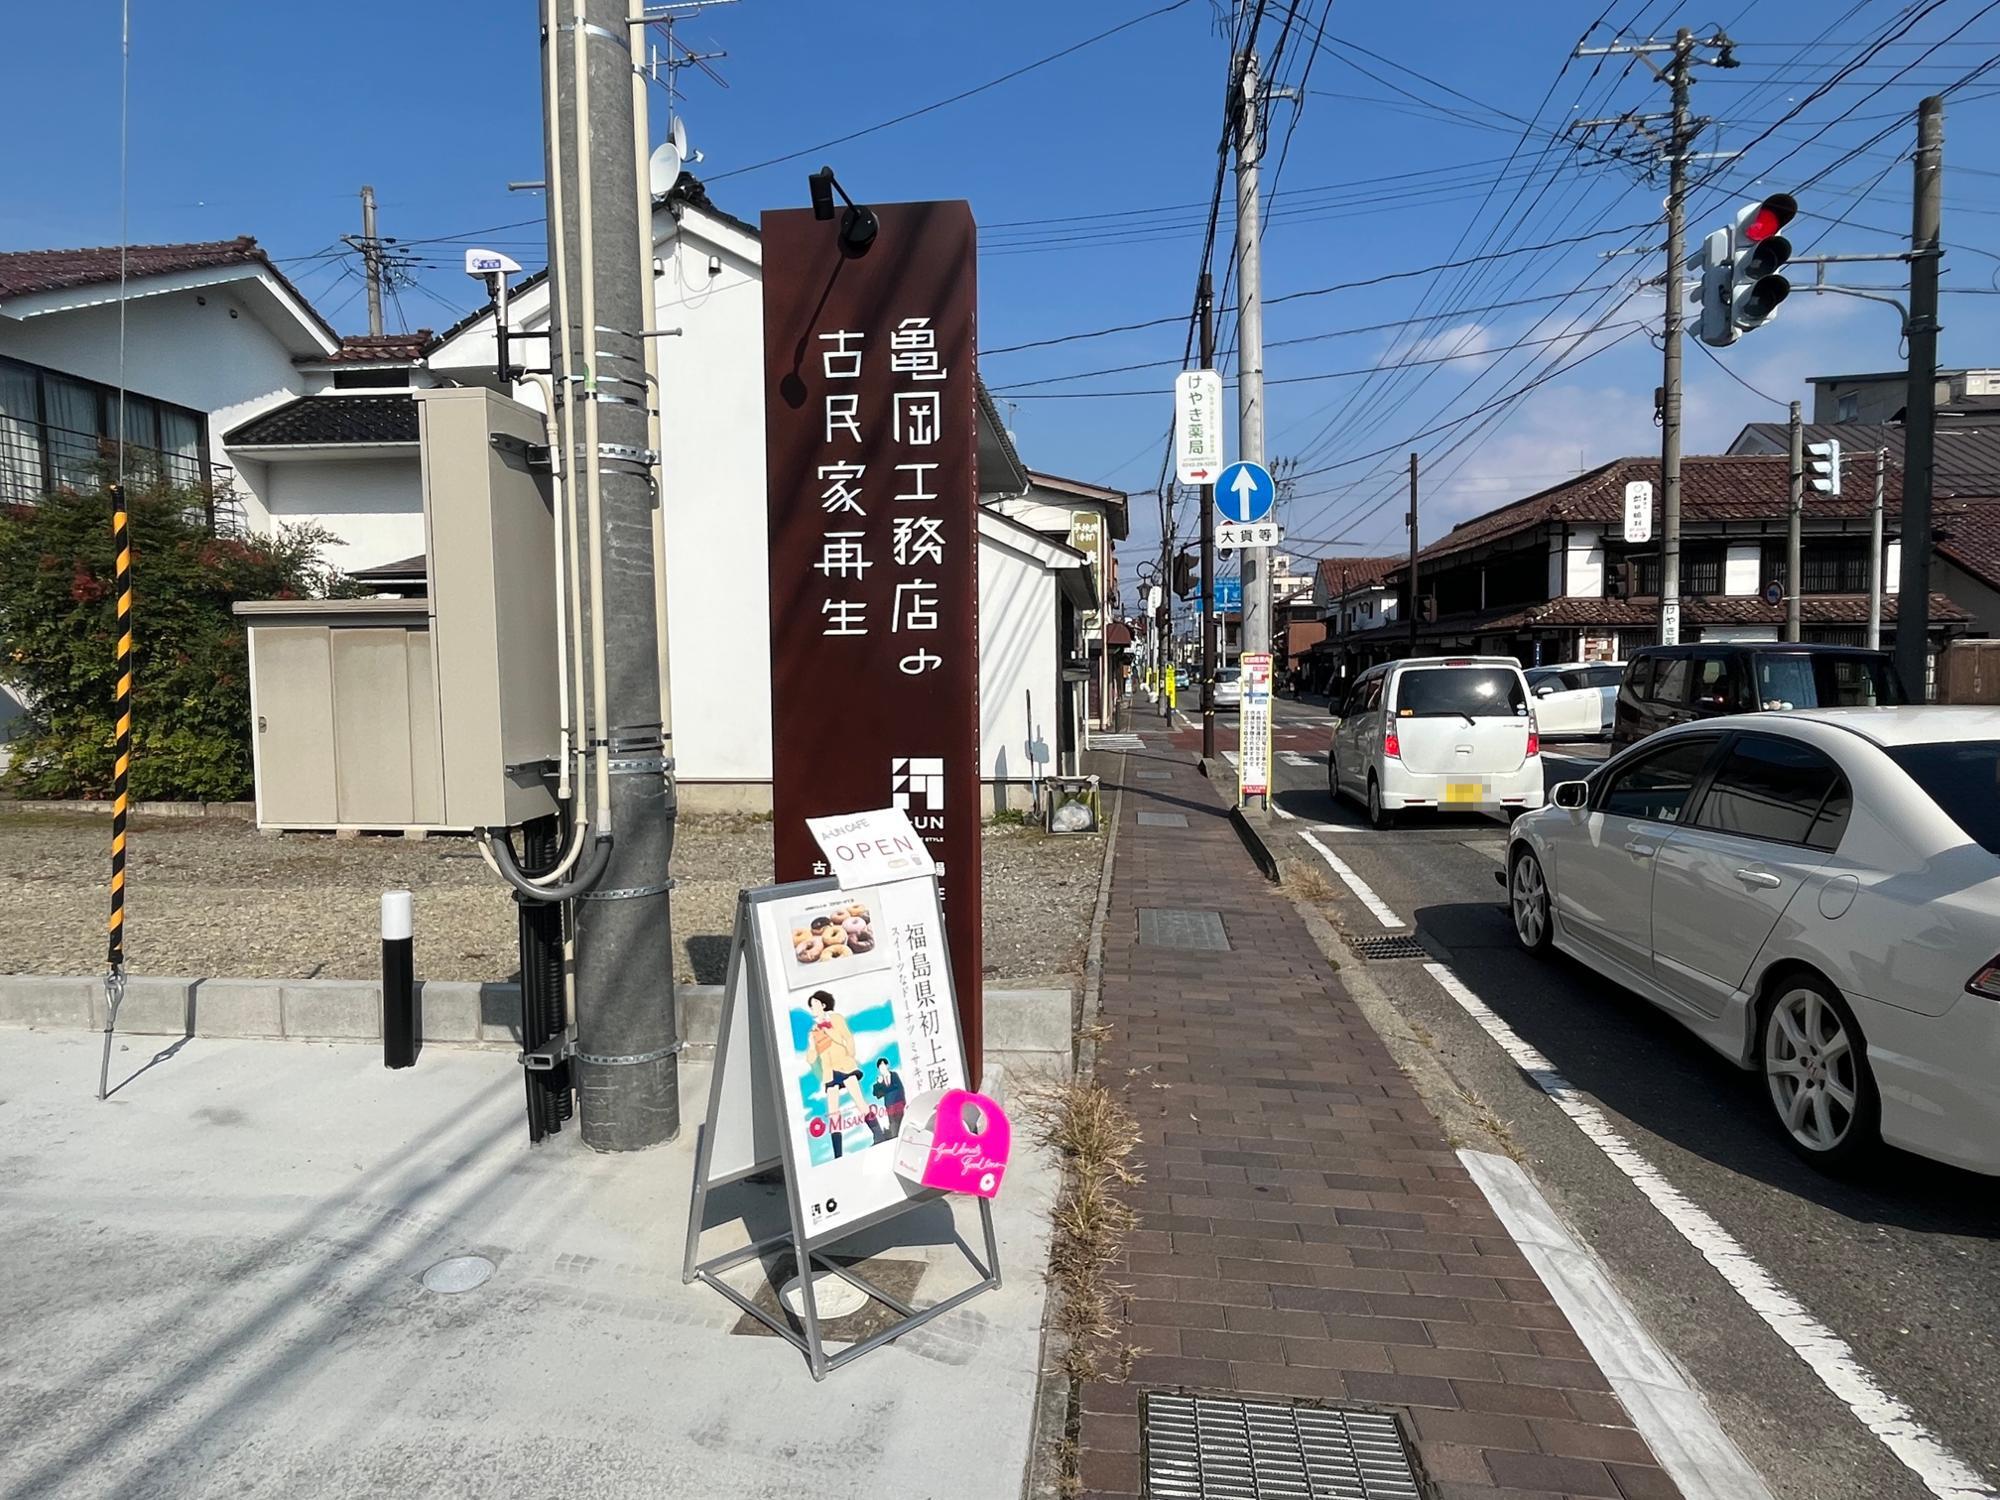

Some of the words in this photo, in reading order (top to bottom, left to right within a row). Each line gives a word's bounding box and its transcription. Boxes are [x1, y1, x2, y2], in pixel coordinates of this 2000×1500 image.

[1188, 375, 1204, 455] けやき薬局
[813, 329, 874, 636] 古民家再生
[890, 317, 947, 675] 亀岡工務店の
[1220, 528, 1272, 544] 大貨等
[836, 835, 914, 862] OPEN
[905, 922, 950, 1090] 福島県初上陸
